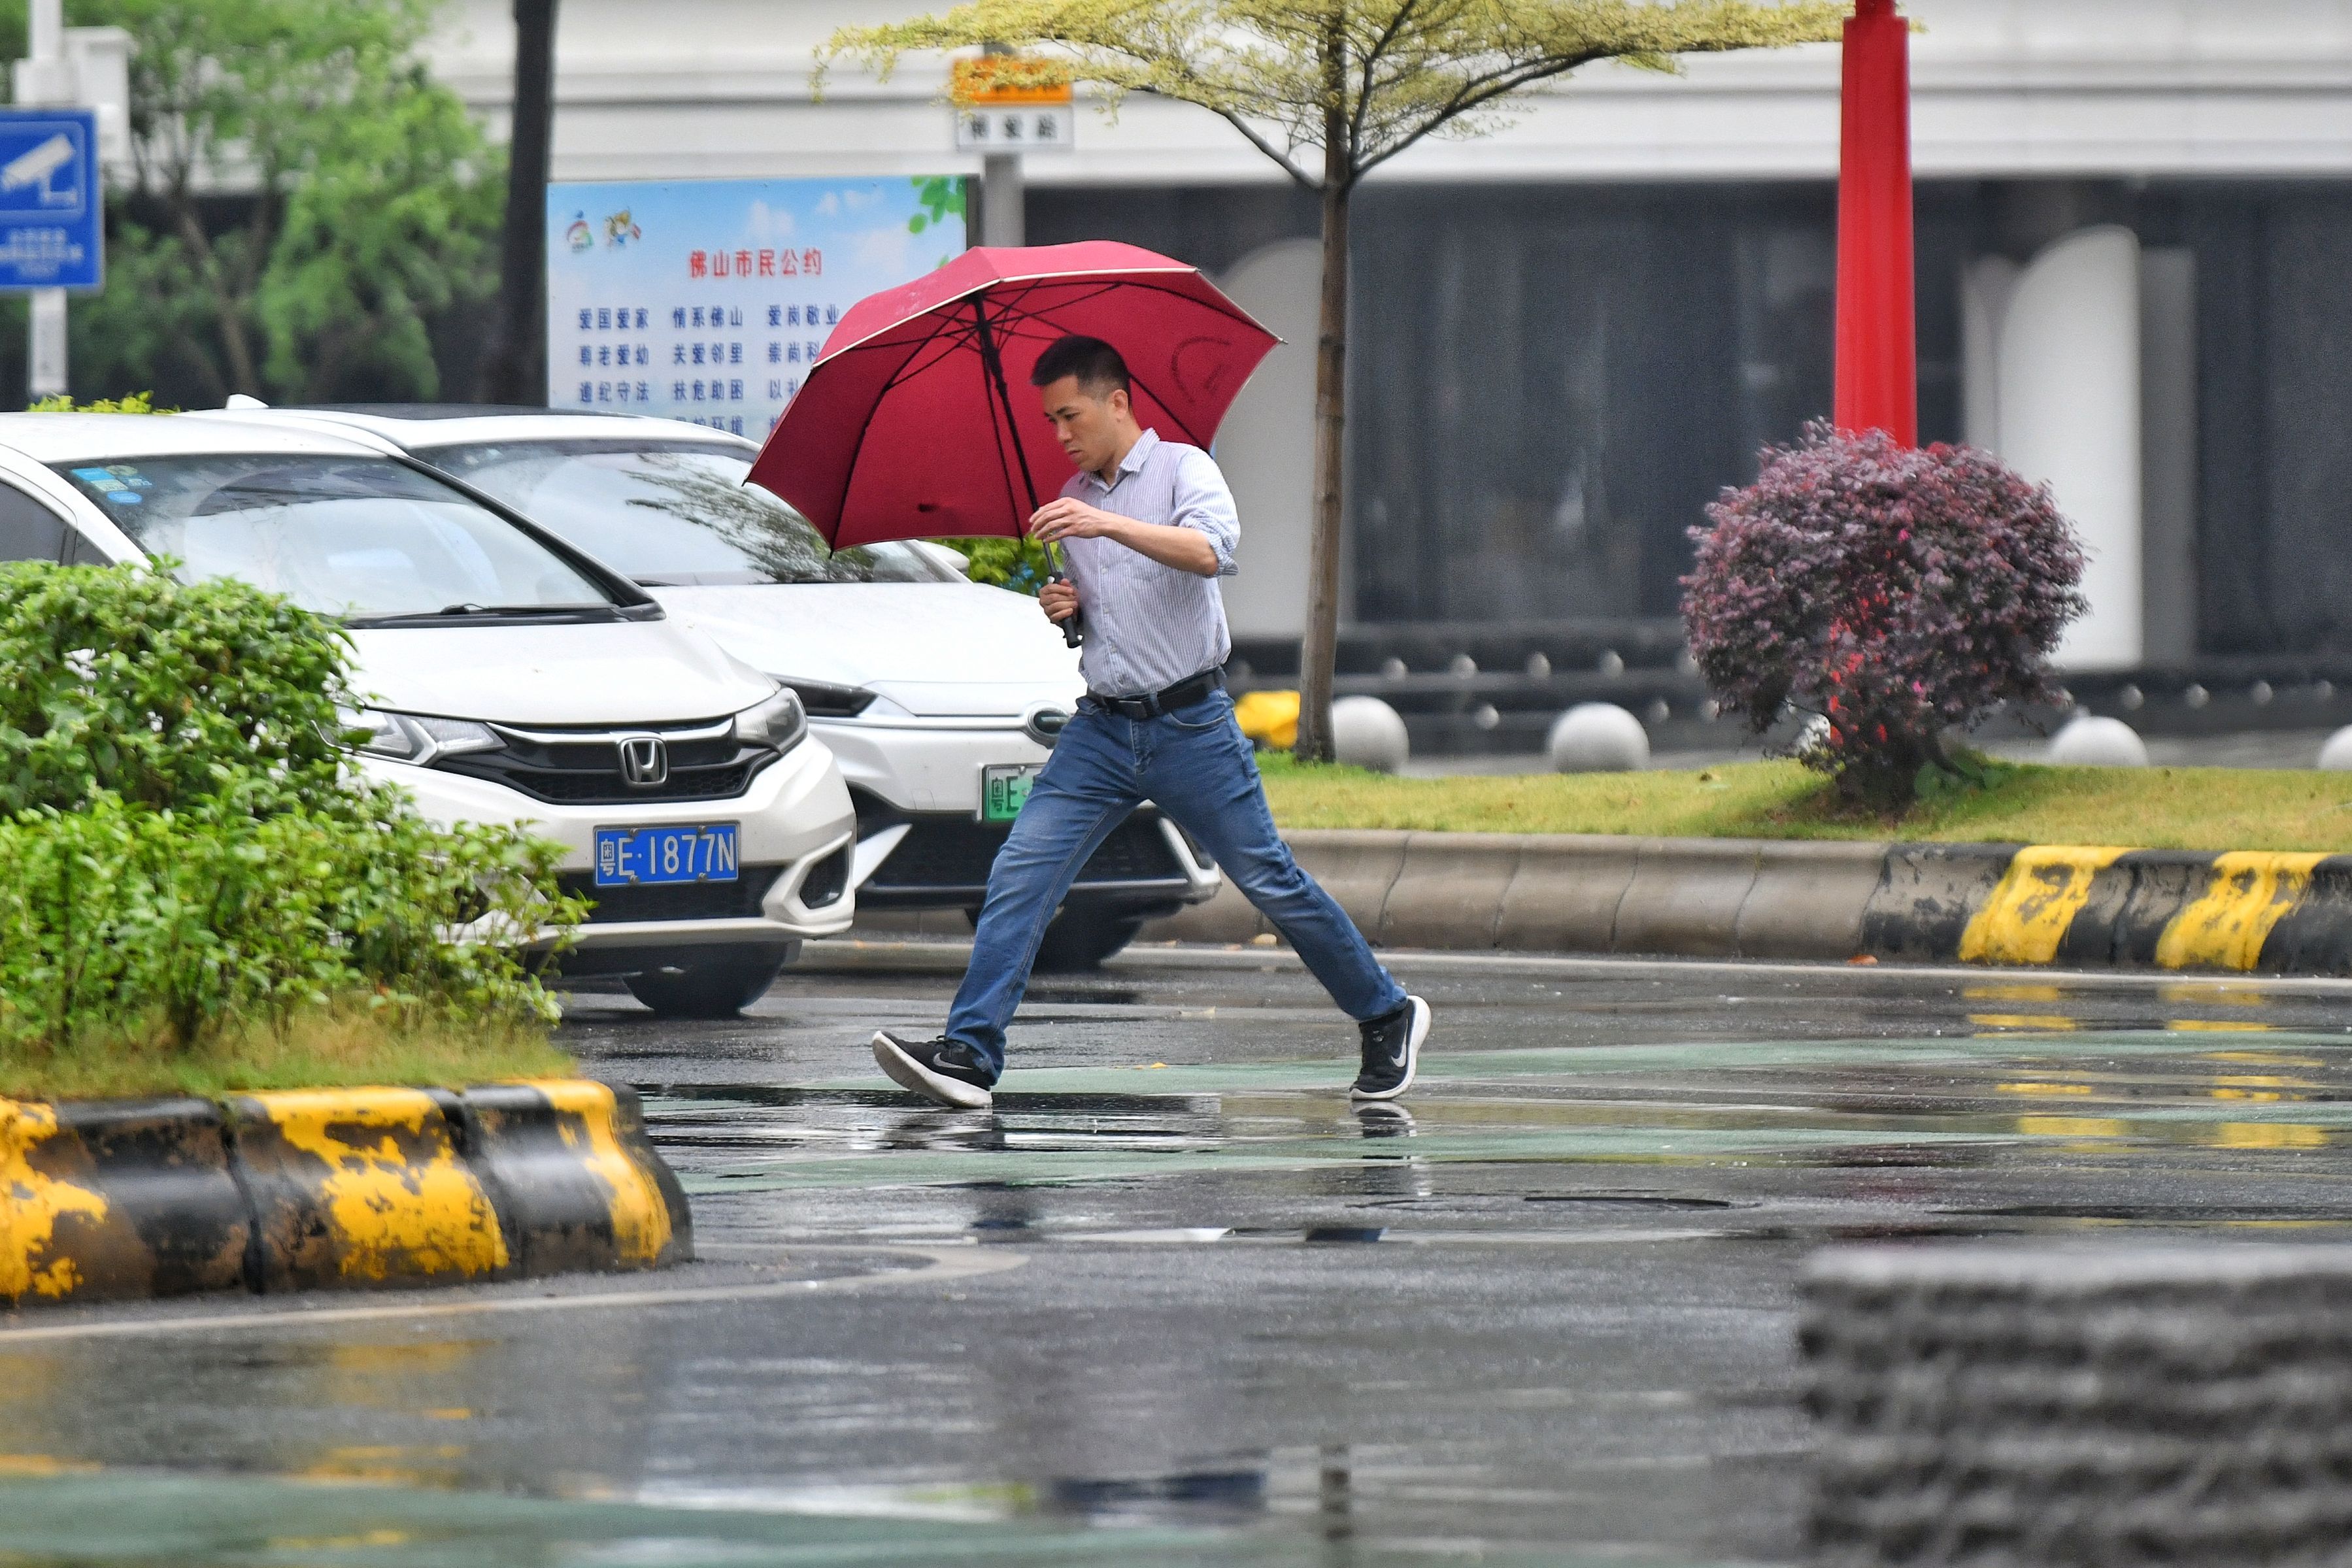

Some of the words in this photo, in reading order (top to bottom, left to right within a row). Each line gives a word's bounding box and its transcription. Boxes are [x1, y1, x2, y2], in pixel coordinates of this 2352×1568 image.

[690, 248, 822, 278] 佛山市民公约
[579, 307, 648, 329] 爱国爱家
[673, 305, 743, 328] 情系佛山
[769, 304, 839, 326] 爱岗敬业
[579, 344, 649, 366] 尊老爱幼
[673, 342, 743, 364] 关爱邻里
[579, 380, 649, 403] 遵纪守法
